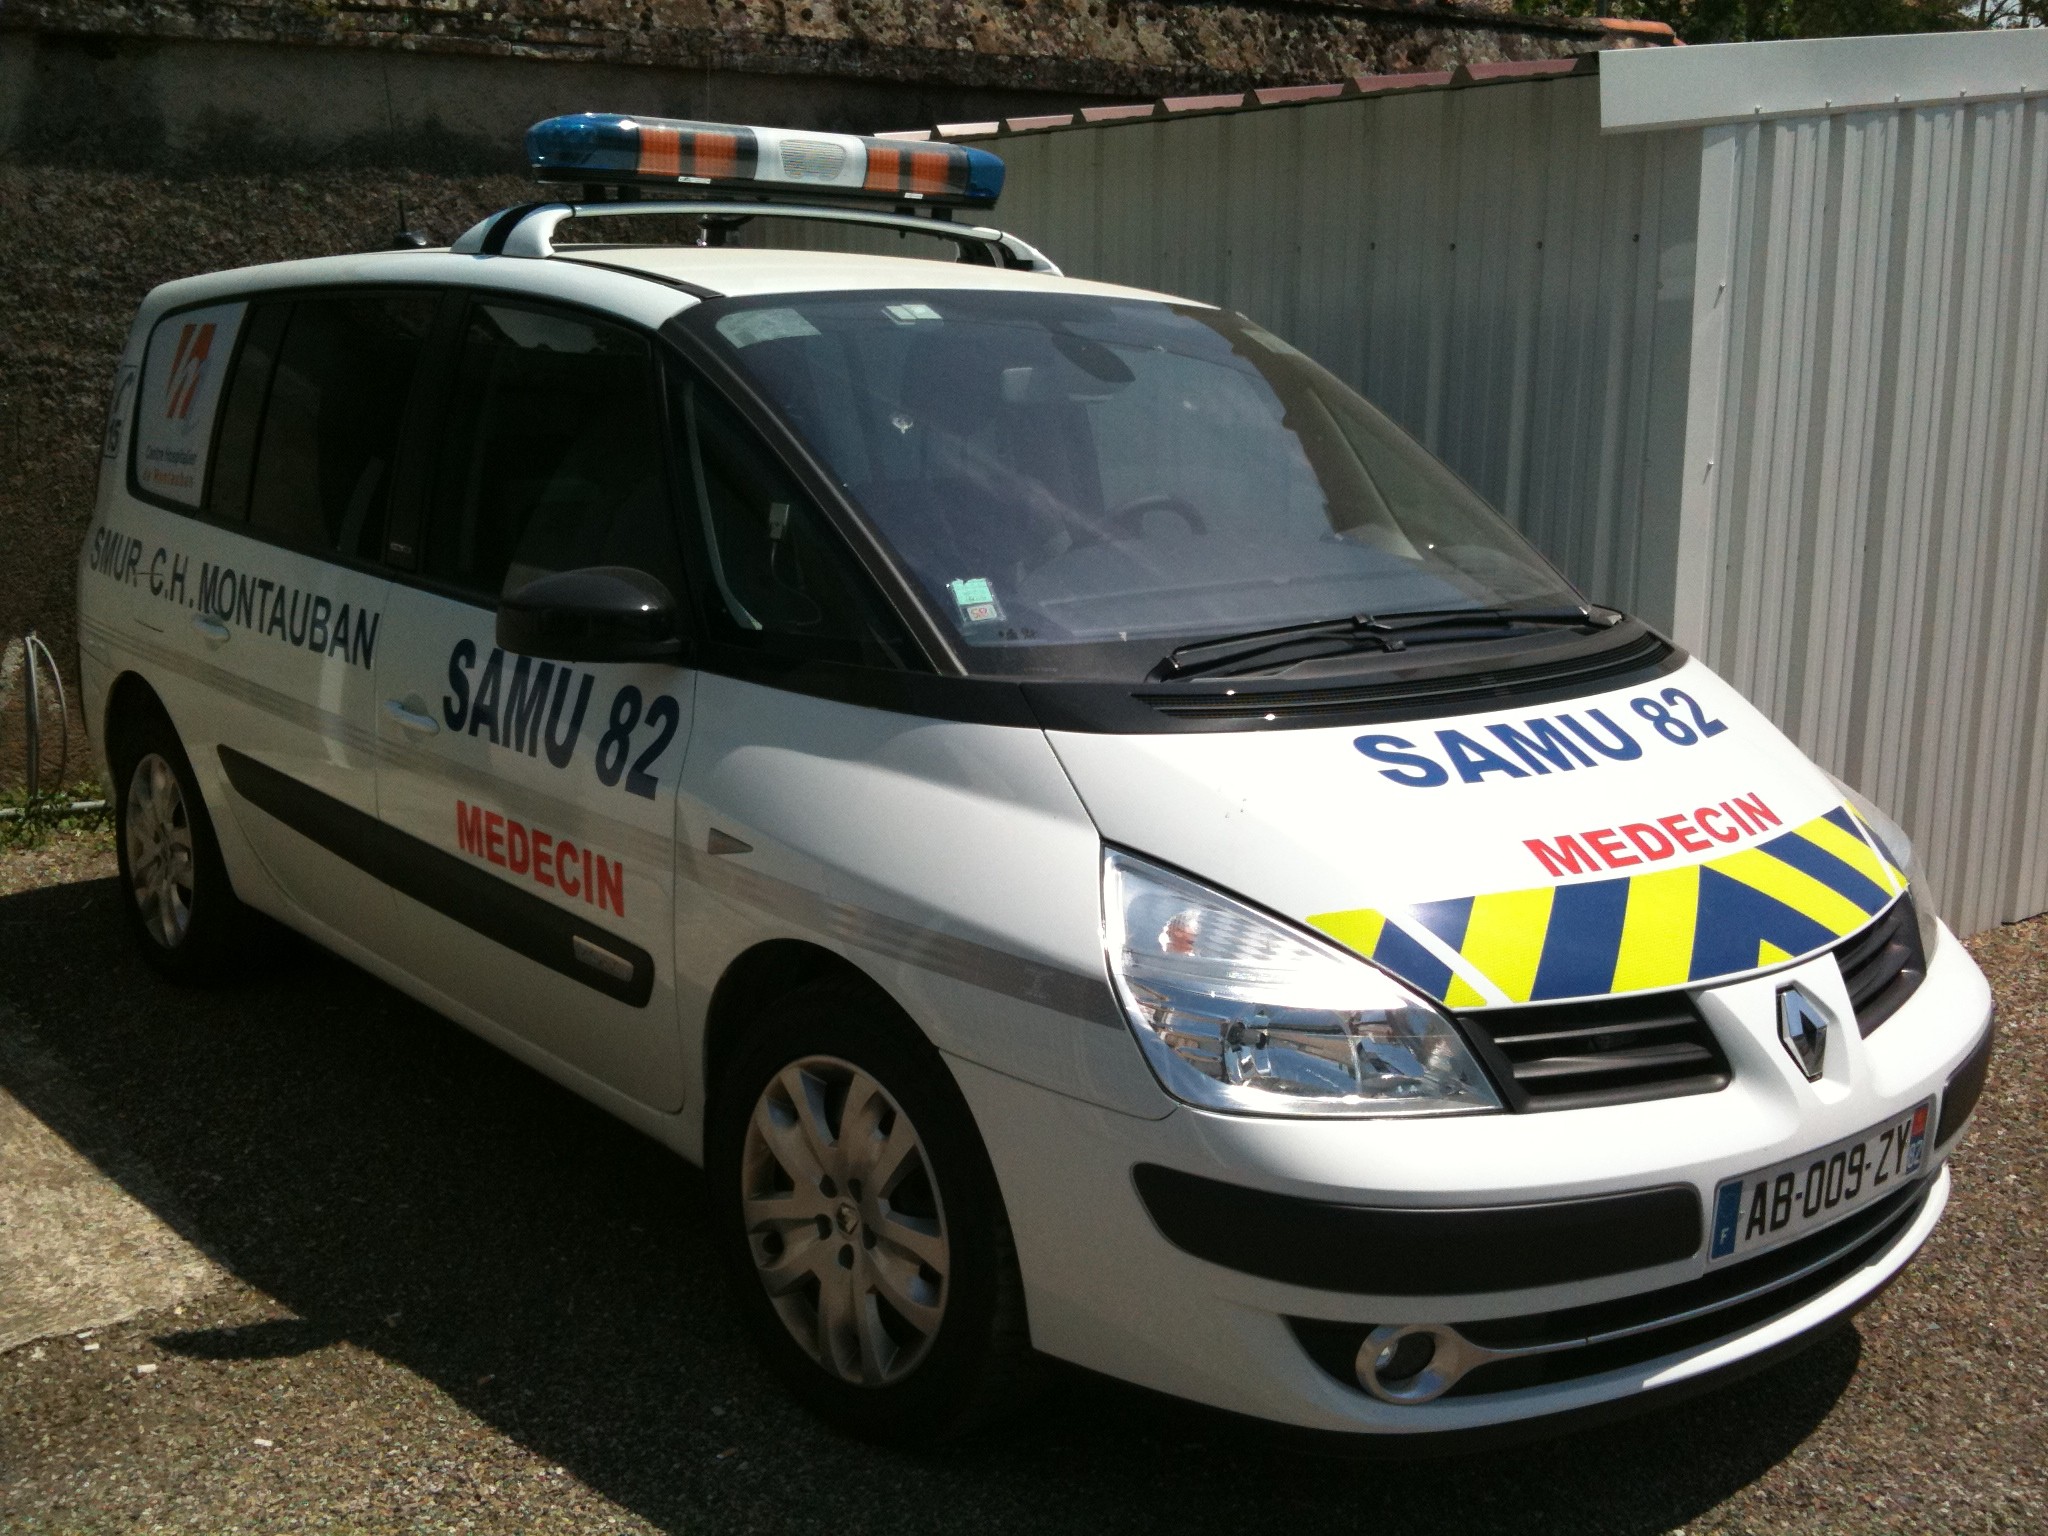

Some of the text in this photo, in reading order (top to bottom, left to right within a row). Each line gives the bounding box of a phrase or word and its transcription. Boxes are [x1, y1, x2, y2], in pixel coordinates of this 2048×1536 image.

[90, 526, 142, 588] SMUR
[443, 638, 680, 801] SAMU 82
[1353, 687, 1728, 788] SAMU 82
[456, 800, 625, 918] MEDECIN
[1522, 791, 1784, 877] MEDECIN
[1744, 1119, 1912, 1241] AB-009-ZY
